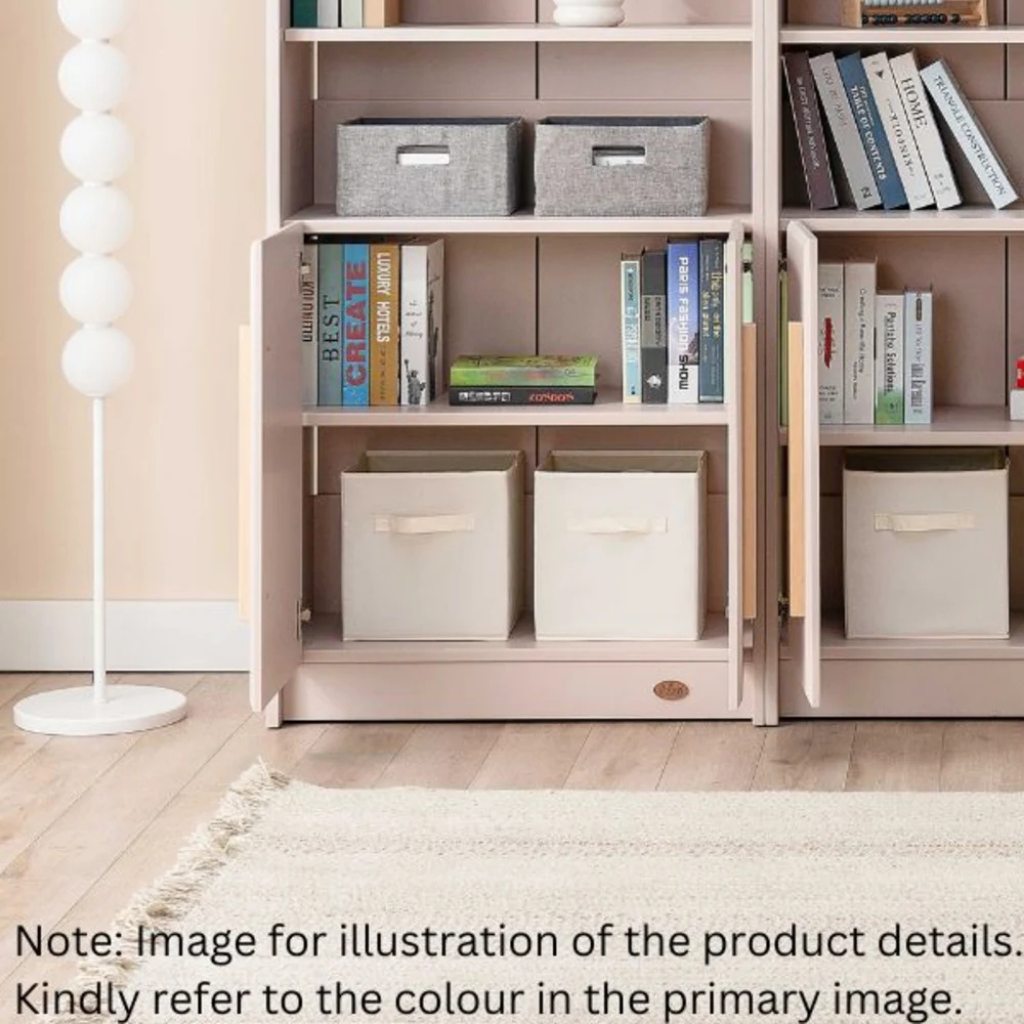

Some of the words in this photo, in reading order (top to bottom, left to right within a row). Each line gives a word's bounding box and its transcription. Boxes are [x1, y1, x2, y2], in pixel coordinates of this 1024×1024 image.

[900, 77, 928, 130] HOME
[933, 75, 964, 125] TRIANGLE
[960, 122, 1008, 196] CONSTRUCTION
[376, 252, 391, 296] LUXURY
[322, 295, 340, 362] BEST
[345, 260, 368, 387] CREATE
[376, 301, 391, 343] HOTELS
[678, 354, 689, 390] SHOW
